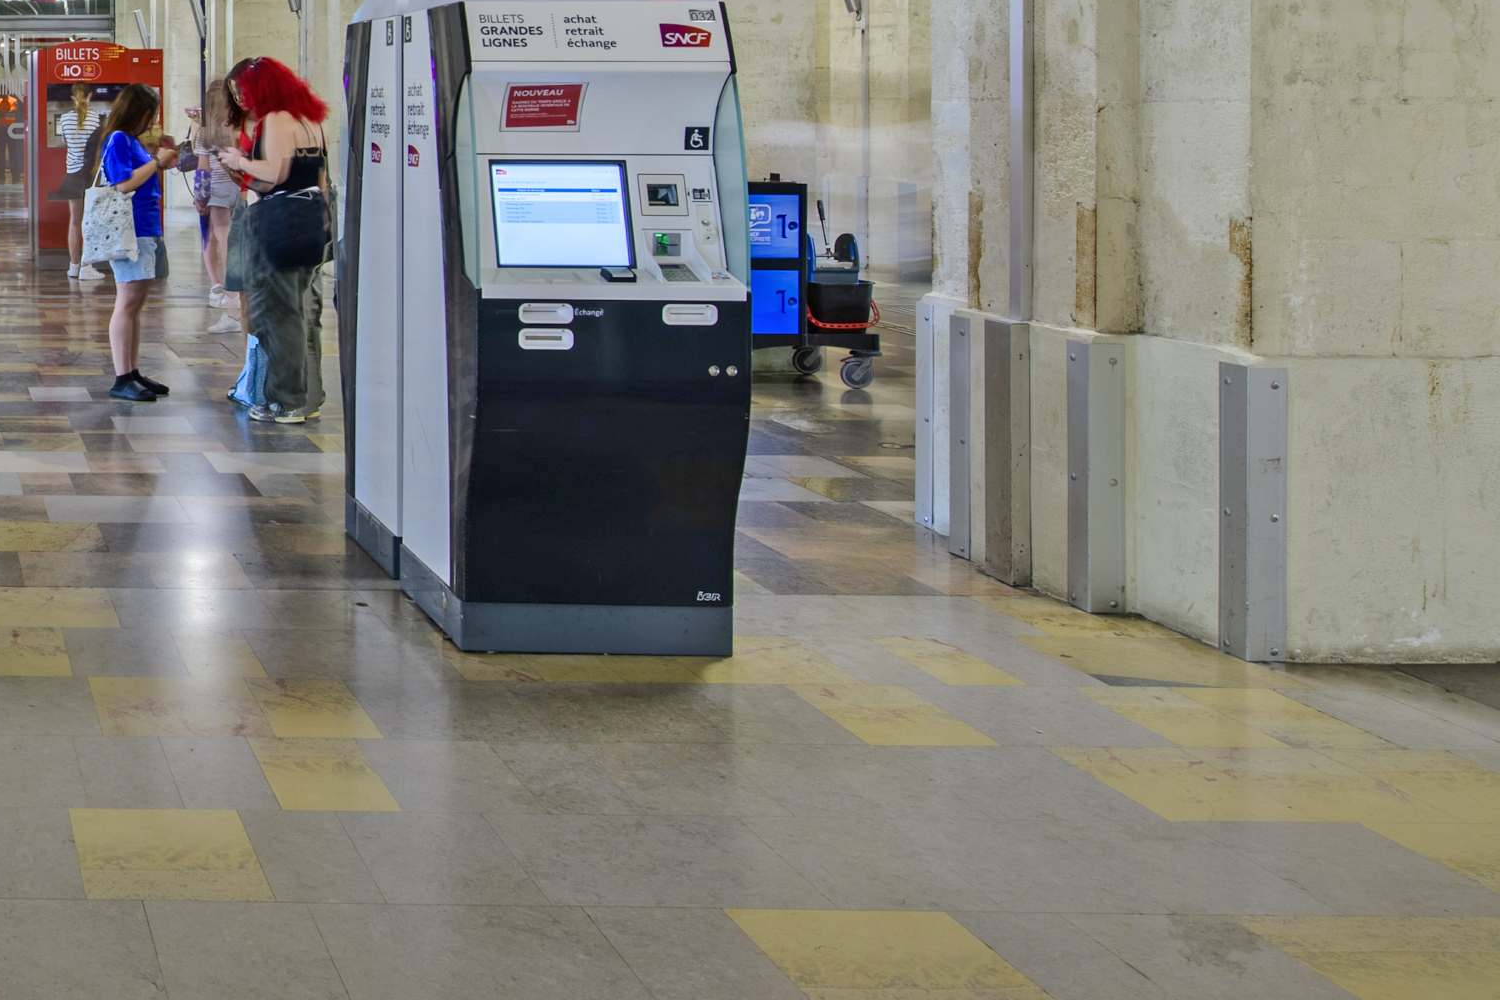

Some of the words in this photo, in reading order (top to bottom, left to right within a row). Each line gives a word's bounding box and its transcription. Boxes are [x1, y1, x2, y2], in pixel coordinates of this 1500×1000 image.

[479, 14, 524, 23] BILLETS
[563, 14, 597, 24] achat
[690, 12, 712, 21] 032
[480, 26, 543, 36] GRANDES
[565, 26, 605, 36] retrait
[482, 38, 528, 47] LIGNES
[567, 38, 617, 50] échange
[663, 32, 708, 45] SNCF
[56, 48, 100, 60] BILLETS
[371, 85, 384, 98] achat
[408, 82, 422, 97] achat
[513, 89, 563, 97] NOUVEAU
[371, 102, 386, 116] retrait
[408, 101, 425, 116] retrait
[371, 120, 390, 138] échange
[408, 120, 429, 139] échange
